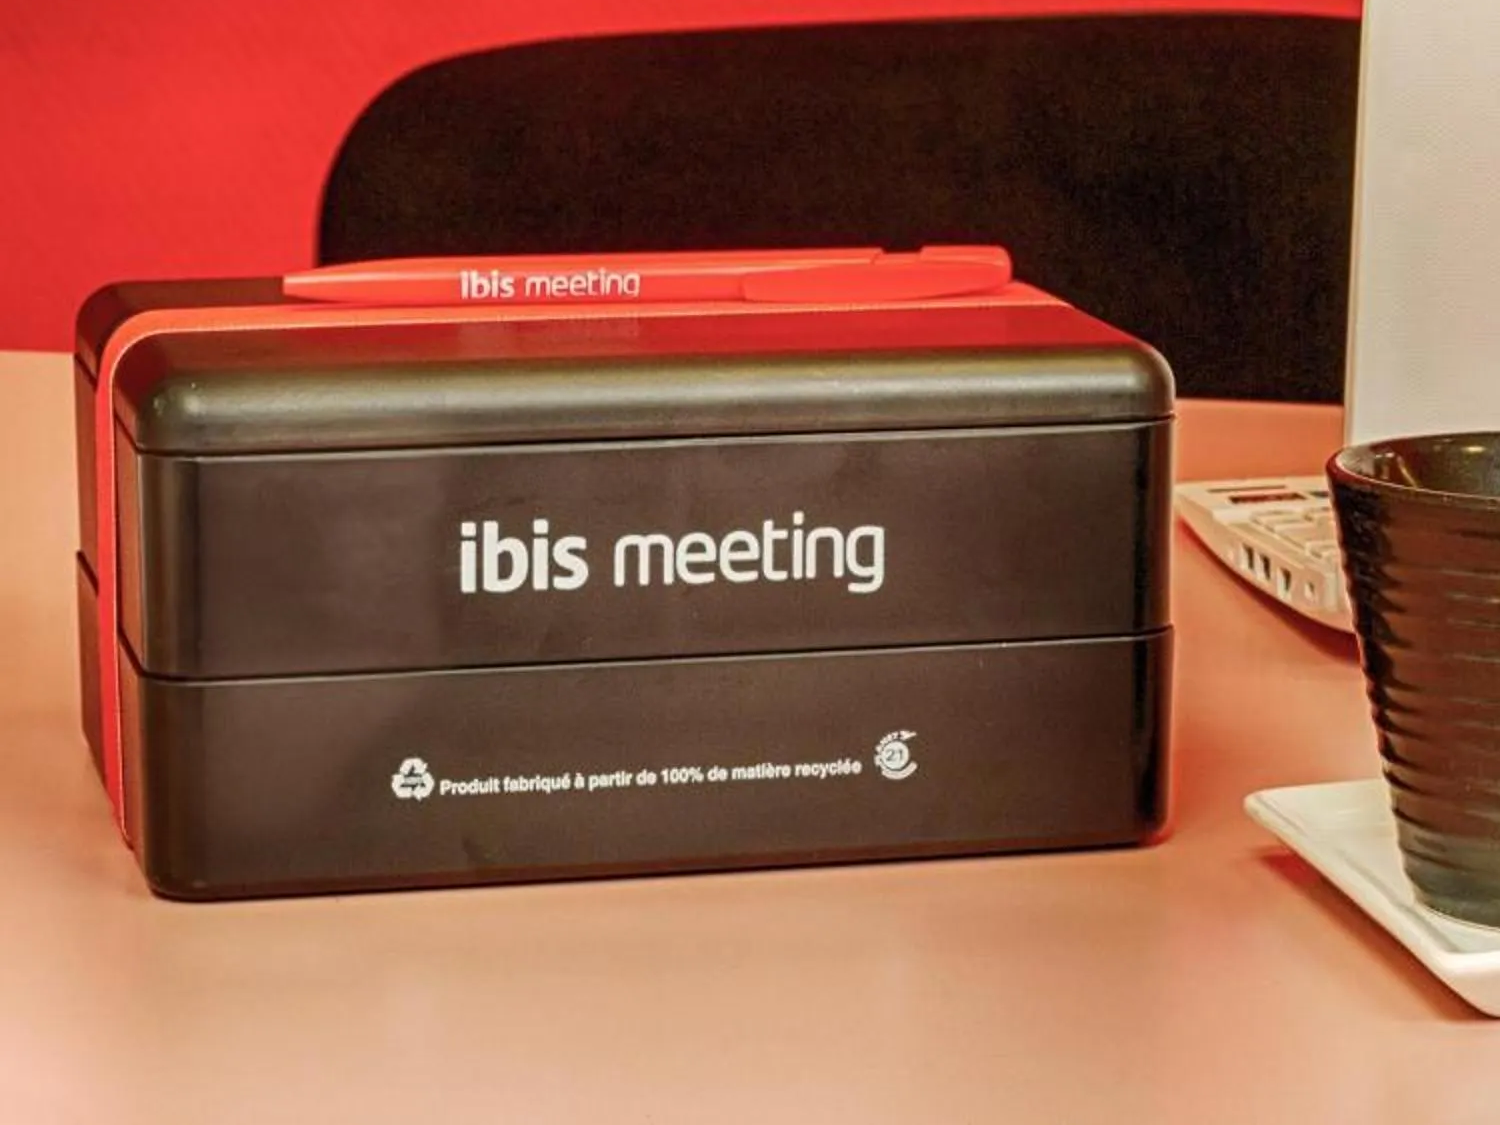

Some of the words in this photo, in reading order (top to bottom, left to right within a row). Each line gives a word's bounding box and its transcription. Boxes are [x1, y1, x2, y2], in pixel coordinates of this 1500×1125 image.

[524, 268, 641, 297] meeting
[461, 518, 589, 593] ibis
[613, 511, 885, 593] meeting
[885, 748, 905, 763] 21
[439, 778, 500, 796] Produit
[503, 772, 571, 794] fabriqué
[574, 772, 585, 789] à
[588, 770, 632, 792] partir
[636, 769, 658, 786] de
[660, 766, 704, 785] 100%
[707, 764, 728, 782] de
[731, 761, 791, 781] matière
[794, 759, 863, 779] recyclée
